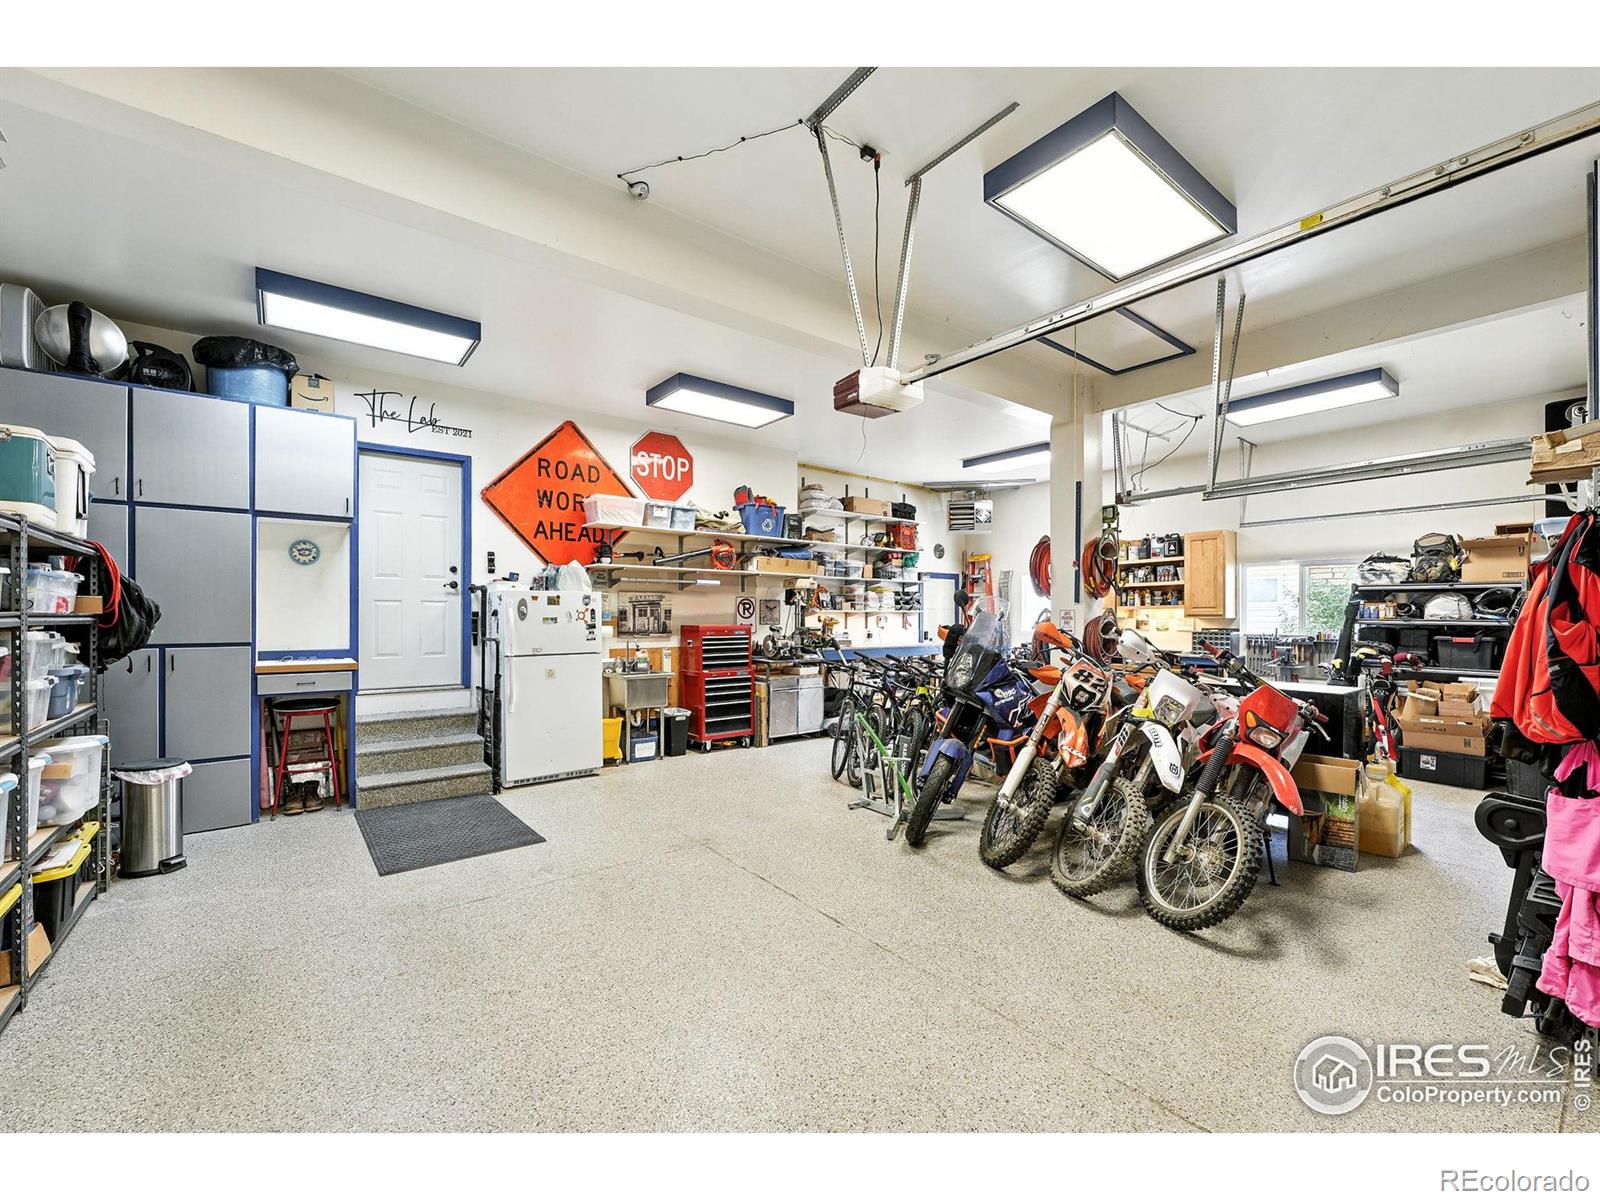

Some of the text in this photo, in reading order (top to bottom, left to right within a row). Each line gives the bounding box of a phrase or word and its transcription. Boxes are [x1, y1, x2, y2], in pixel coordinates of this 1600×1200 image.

[353, 389, 441, 433] The Lab
[431, 425, 473, 438] EST 2021
[537, 457, 601, 483] ROAD
[636, 450, 690, 482] STOP
[536, 488, 591, 513] WOR
[533, 520, 608, 544] AHEAD
